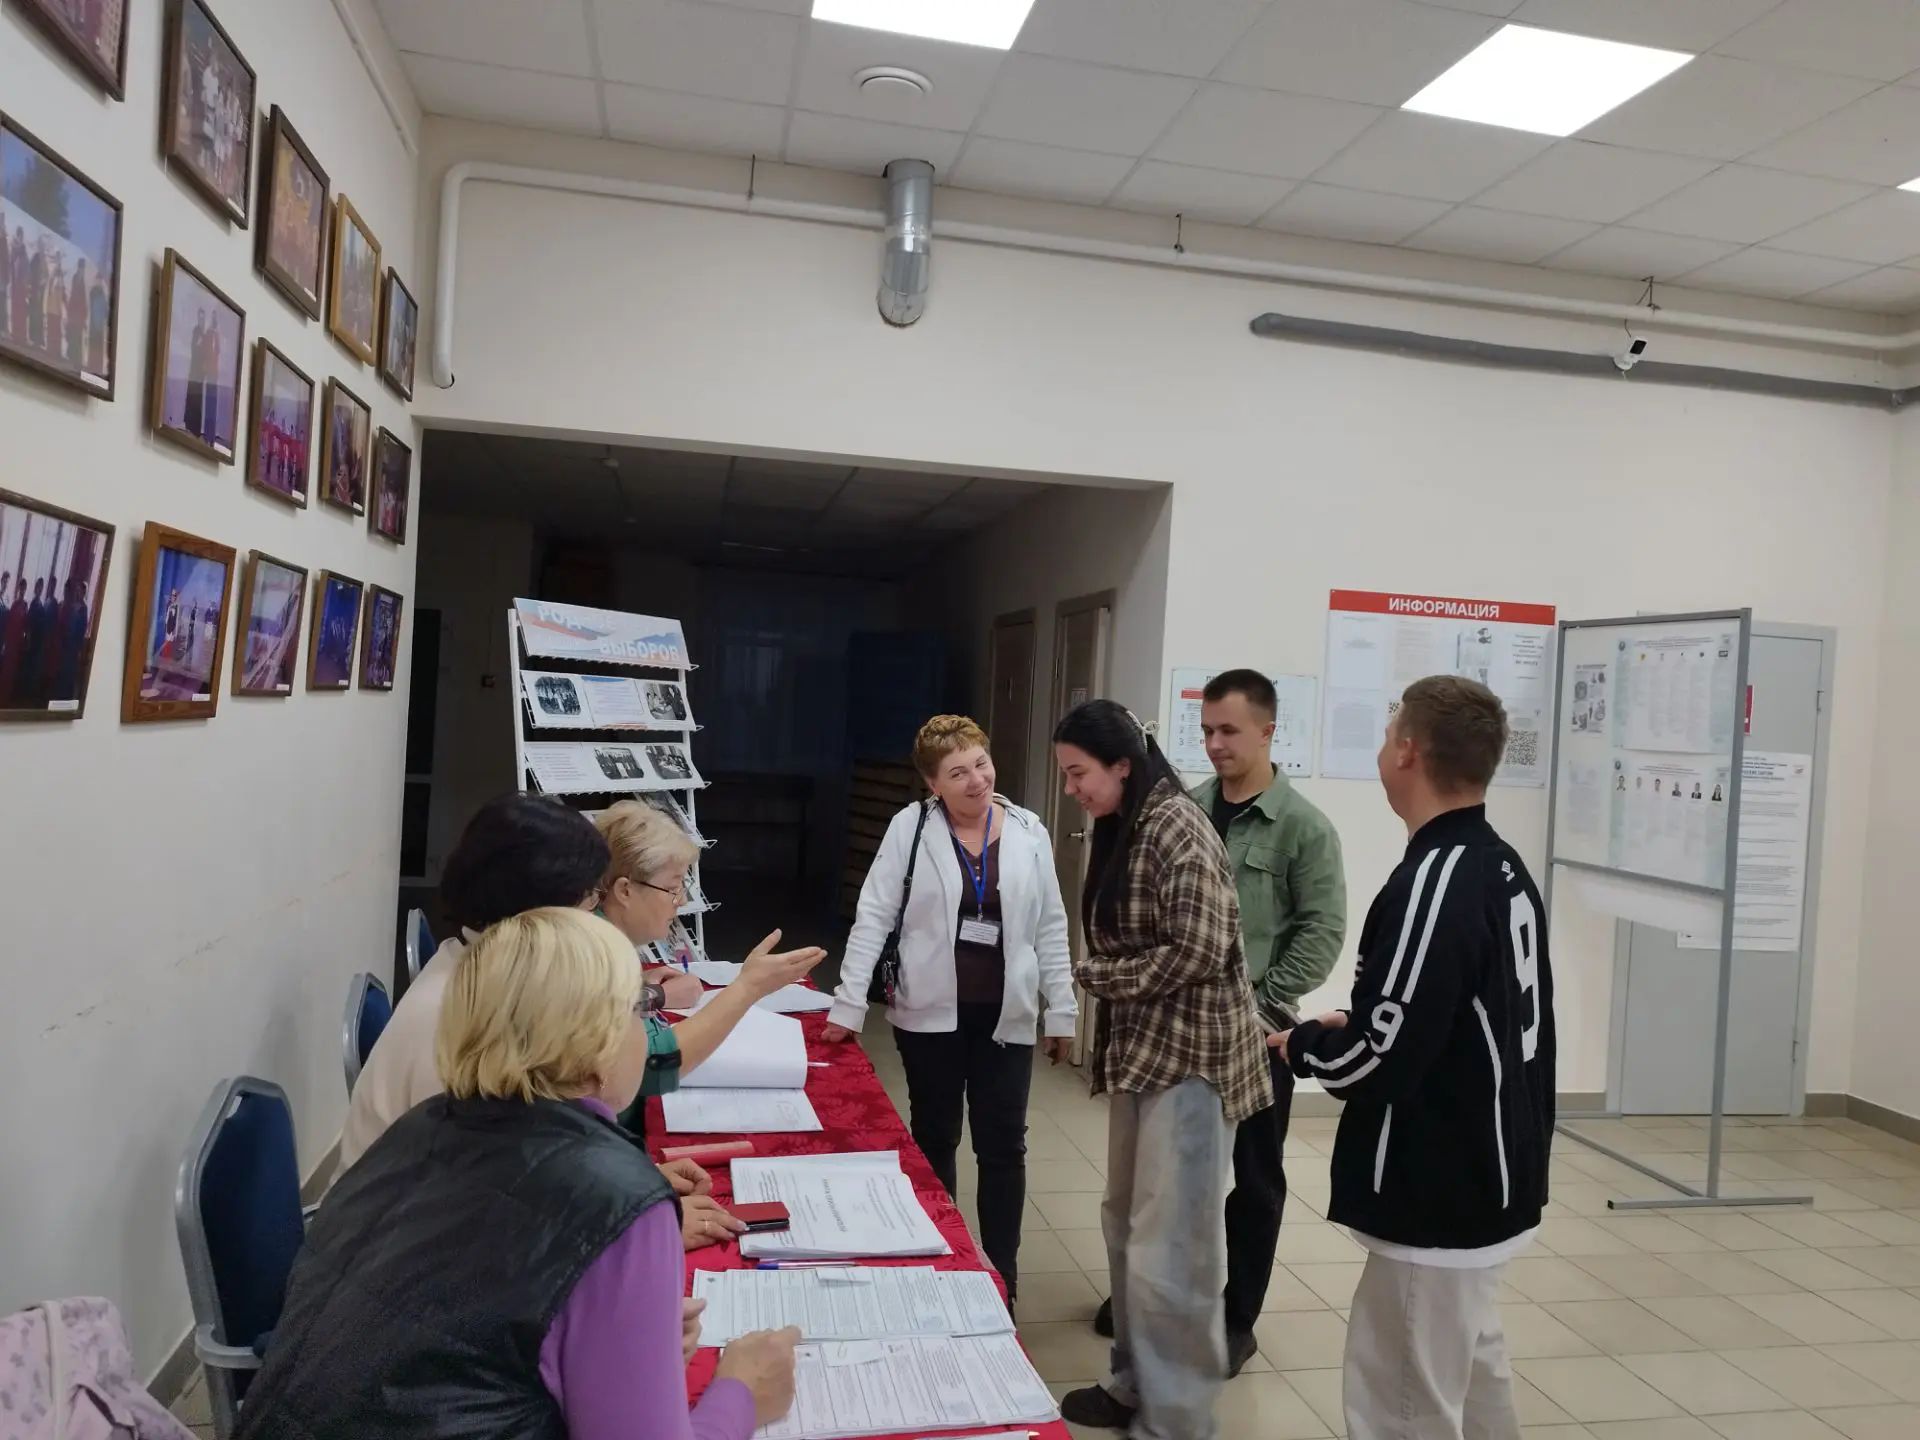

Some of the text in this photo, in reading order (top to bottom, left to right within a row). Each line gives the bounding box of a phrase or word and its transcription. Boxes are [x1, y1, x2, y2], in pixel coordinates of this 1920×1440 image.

[1388, 597, 1500, 619] ИНФОРМАЦИЯ
[600, 637, 681, 662] ВЫБОРОВ
[1366, 1000, 1404, 1054] 9
